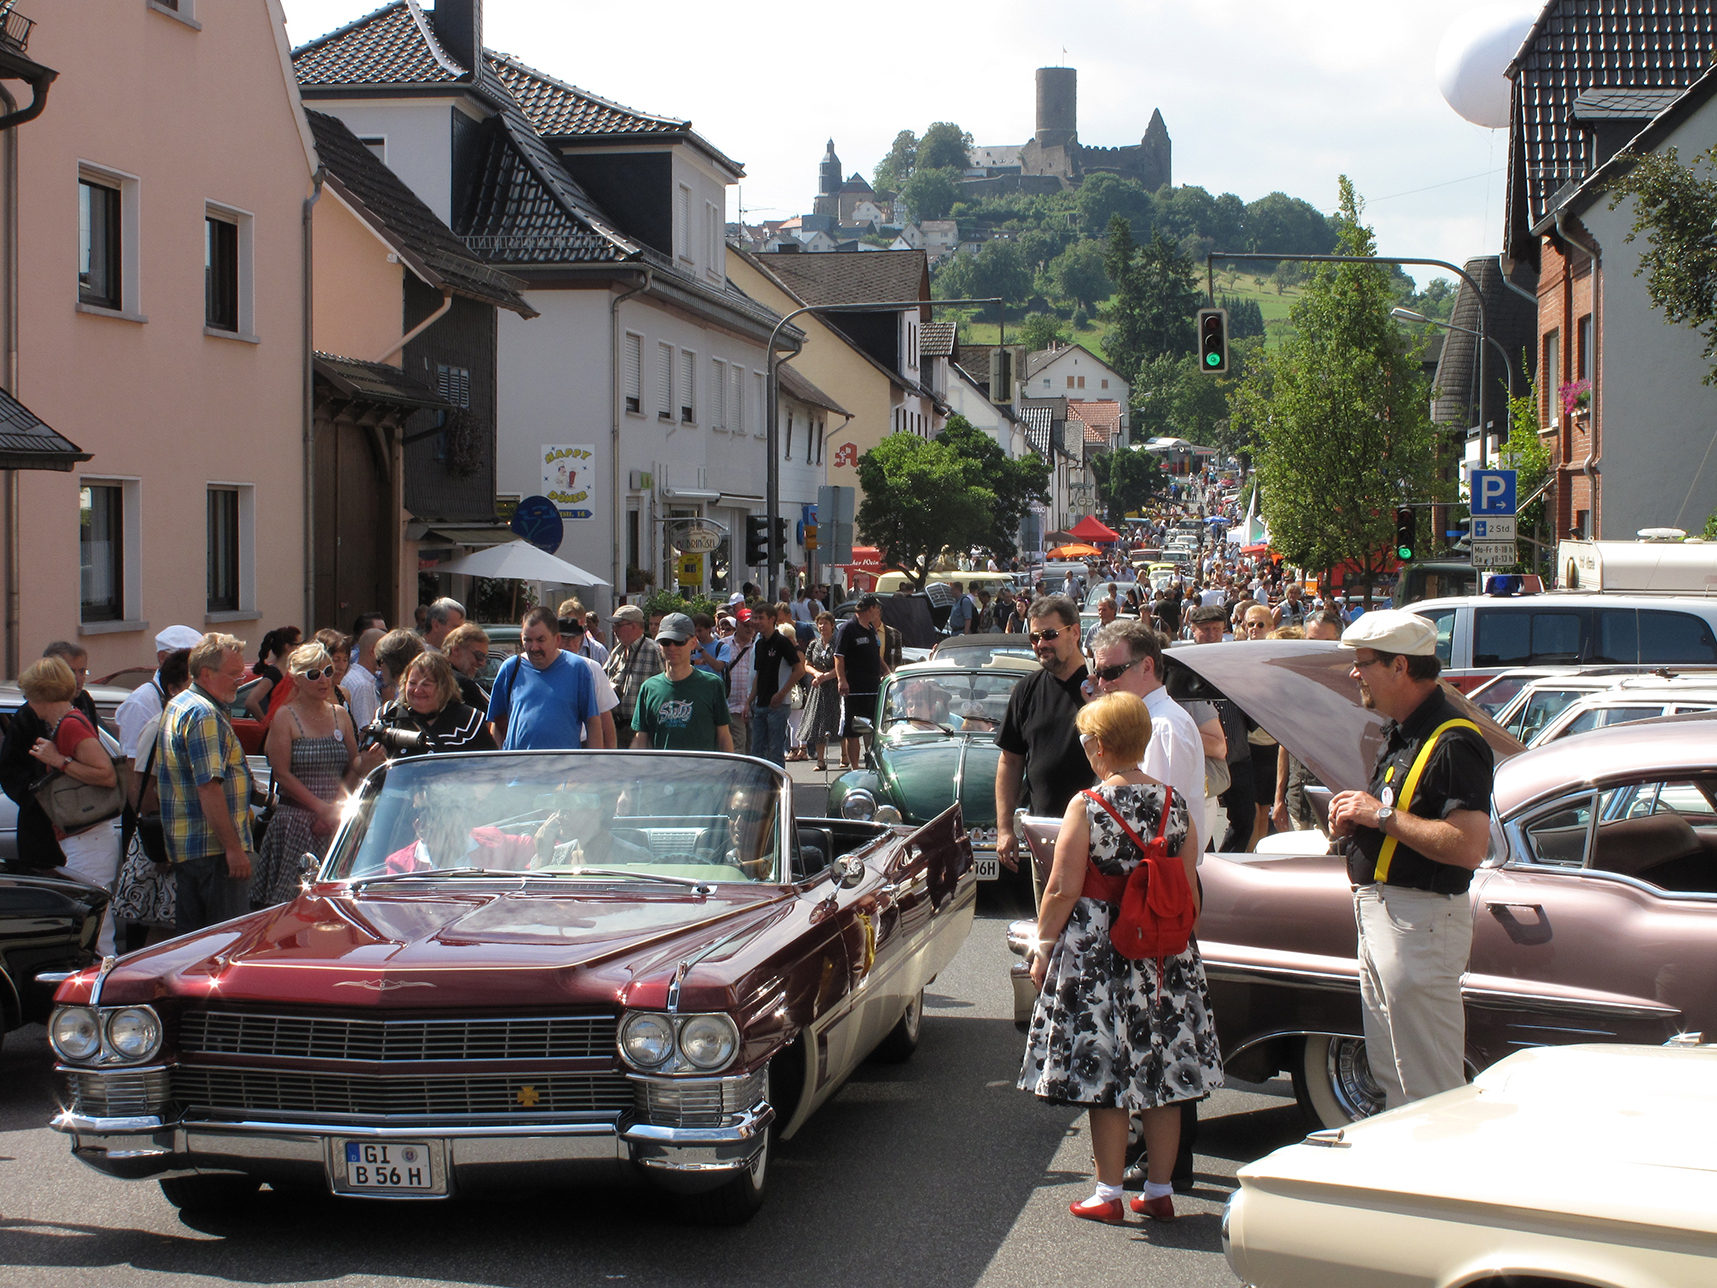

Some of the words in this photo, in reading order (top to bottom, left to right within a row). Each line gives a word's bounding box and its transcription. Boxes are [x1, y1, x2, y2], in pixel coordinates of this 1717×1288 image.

[545, 448, 592, 464] HAPPY
[547, 490, 589, 503] DÖNER
[1481, 475, 1506, 509] P
[1496, 525, 1511, 533] Std.
[862, 558, 879, 566] Wein
[364, 1145, 391, 1164] GI
[355, 1165, 369, 1184] B
[375, 1167, 402, 1185] 56
[408, 1167, 422, 1186] H
